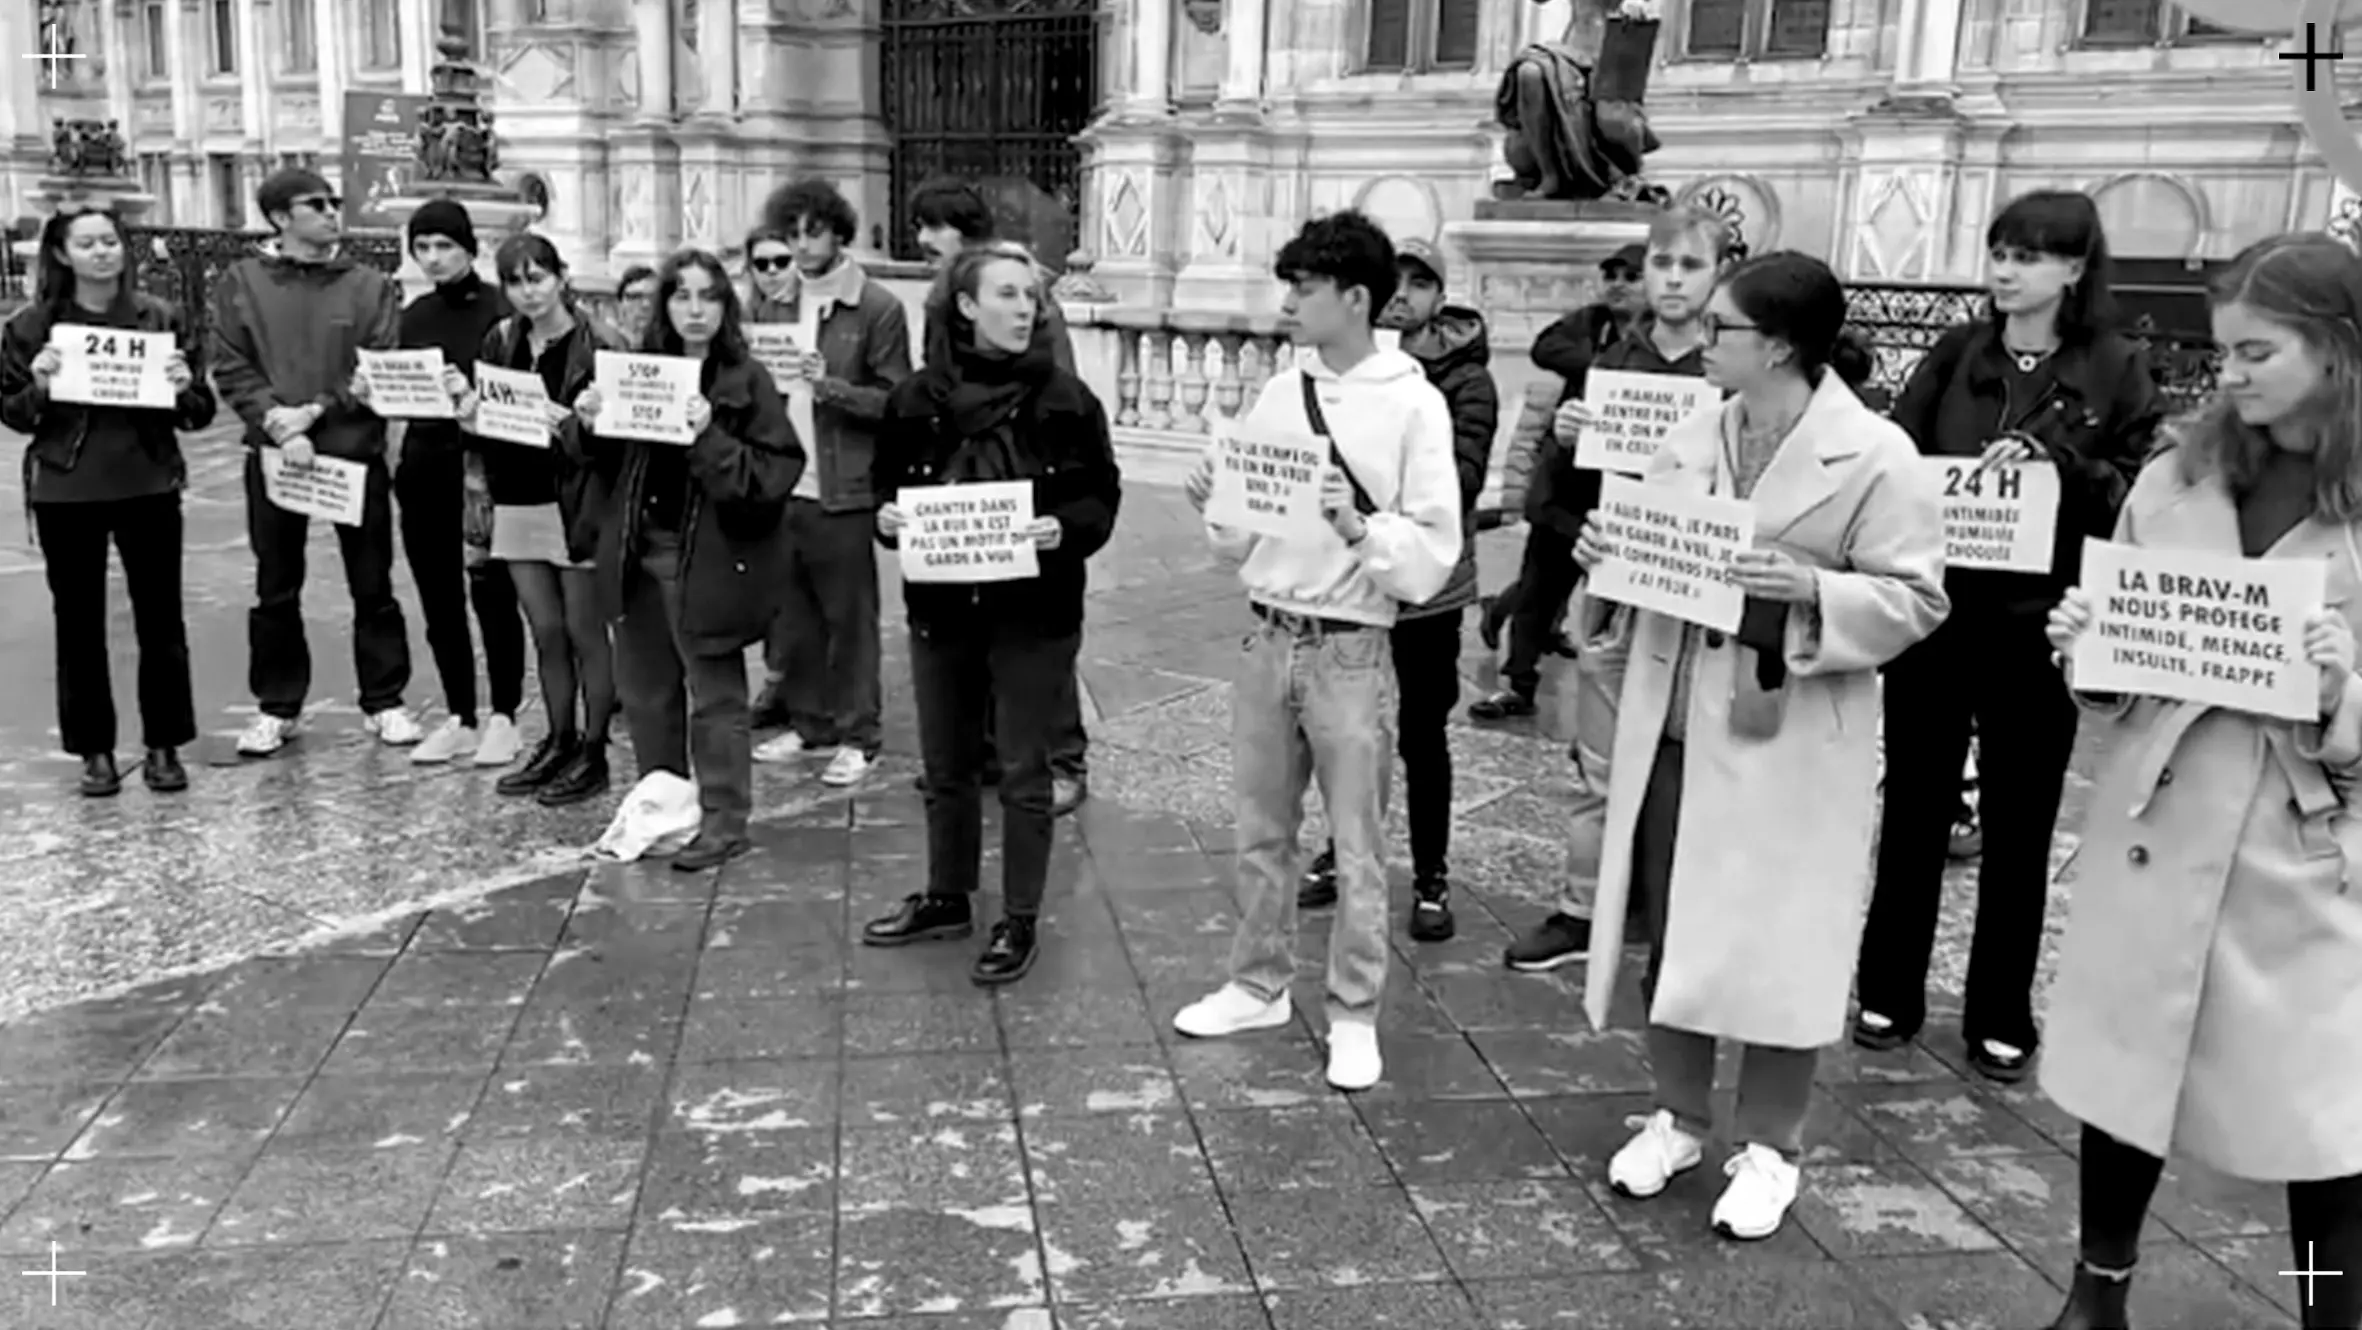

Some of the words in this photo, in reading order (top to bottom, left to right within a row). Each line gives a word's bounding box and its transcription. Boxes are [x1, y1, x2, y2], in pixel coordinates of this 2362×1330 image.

[85, 333, 117, 357] 24
[128, 337, 146, 359] H
[628, 362, 661, 378] STOP
[632, 405, 662, 420] STOP
[1602, 403, 1651, 421] RENTRE
[1629, 423, 1651, 438] ON
[1943, 465, 1982, 498] 24
[1998, 468, 2021, 500] H
[915, 501, 976, 518] CHANTER
[980, 498, 1018, 514] DANS
[924, 519, 939, 534] LA
[942, 517, 967, 533] RUE
[1626, 525, 1667, 548] GARDE
[1703, 521, 1740, 543] PARS
[910, 535, 936, 551] PAS
[938, 534, 960, 550] UN
[963, 531, 1006, 548] MOTIF
[924, 551, 969, 567] GARDE
[985, 549, 1015, 565] VUE
[1623, 545, 1702, 578] COMPRENDS
[1657, 575, 1690, 597] PEUR
[2118, 568, 2149, 594] LA
[2157, 572, 2271, 608] BRAV-M
[2108, 596, 2171, 621] NOUS
[2100, 621, 2194, 652] INTIMIDE,
[2201, 634, 2292, 665] MENACE,
[2112, 647, 2195, 676] INSULTE,
[2201, 660, 2277, 689] FRAPPE
